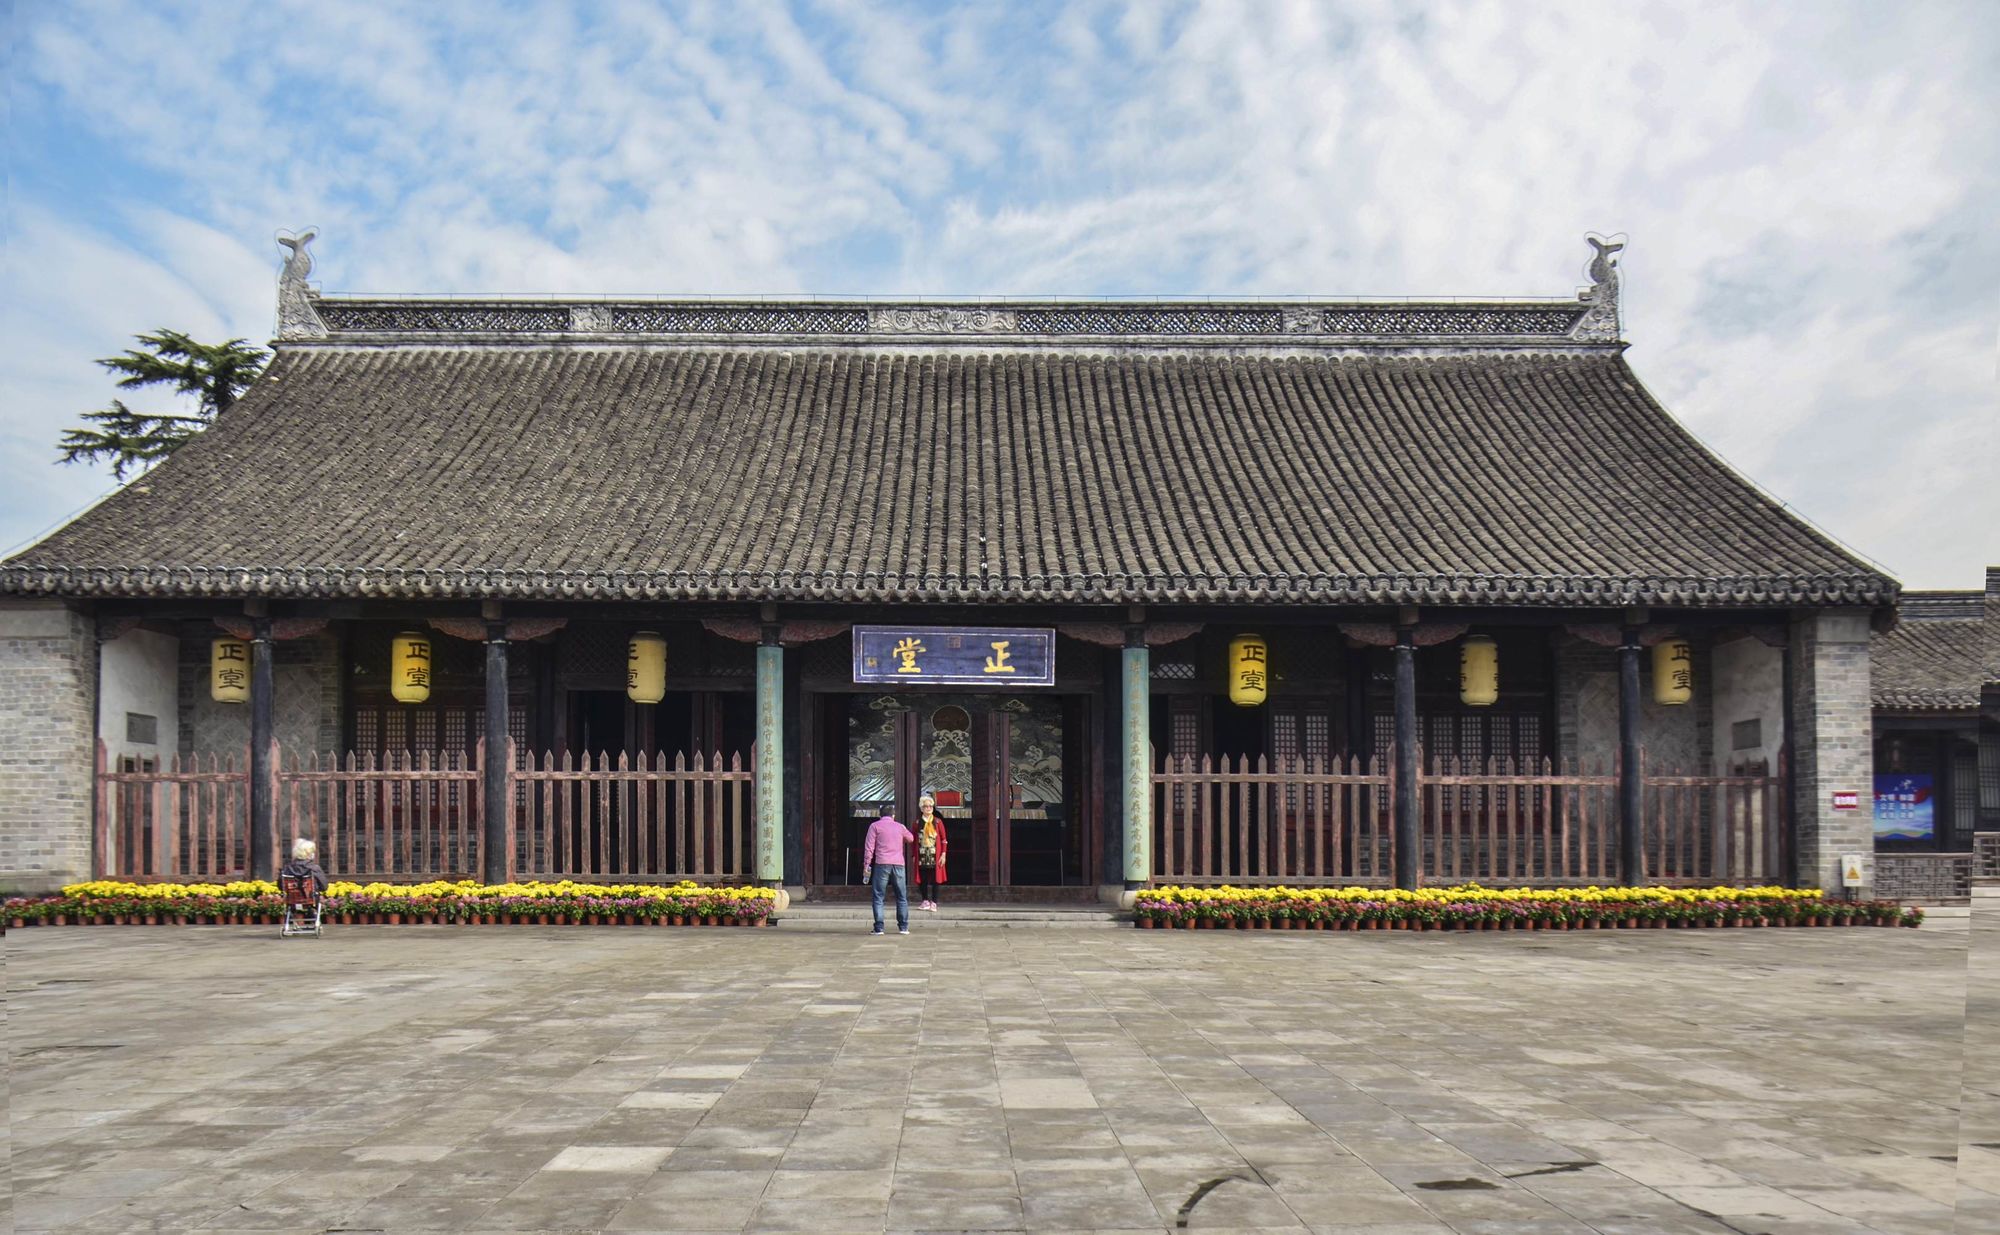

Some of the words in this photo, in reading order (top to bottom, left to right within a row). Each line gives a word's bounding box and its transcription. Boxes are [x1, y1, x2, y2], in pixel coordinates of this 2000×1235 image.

[218, 643, 245, 690] 正堂
[406, 641, 430, 689] 正堂
[892, 637, 1016, 674] 正堂
[1240, 644, 1265, 692] 正堂
[1670, 644, 1692, 690] 正堂
